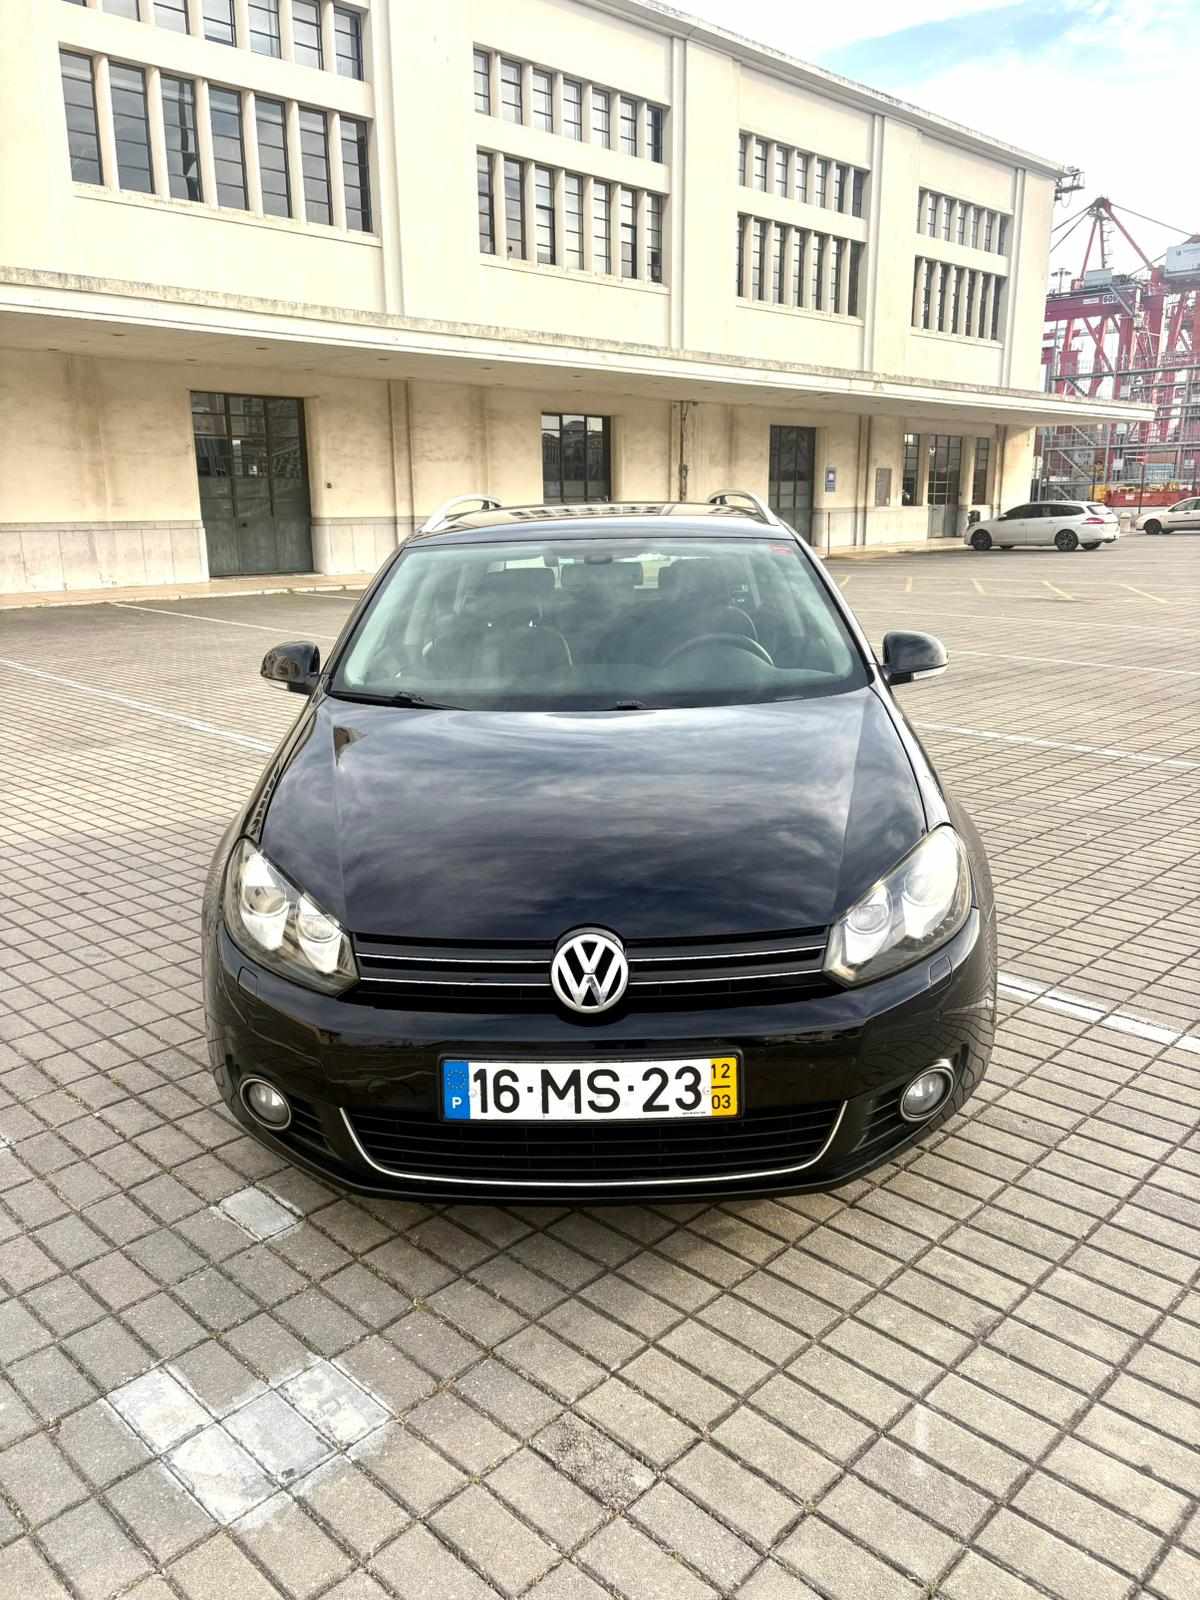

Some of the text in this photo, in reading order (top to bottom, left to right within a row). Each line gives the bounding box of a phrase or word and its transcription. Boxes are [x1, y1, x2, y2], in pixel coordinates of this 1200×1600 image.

[551, 934, 628, 1012] VW
[711, 1063, 731, 1079] 12
[451, 1098, 463, 1110] P
[711, 1094, 731, 1110] 03
